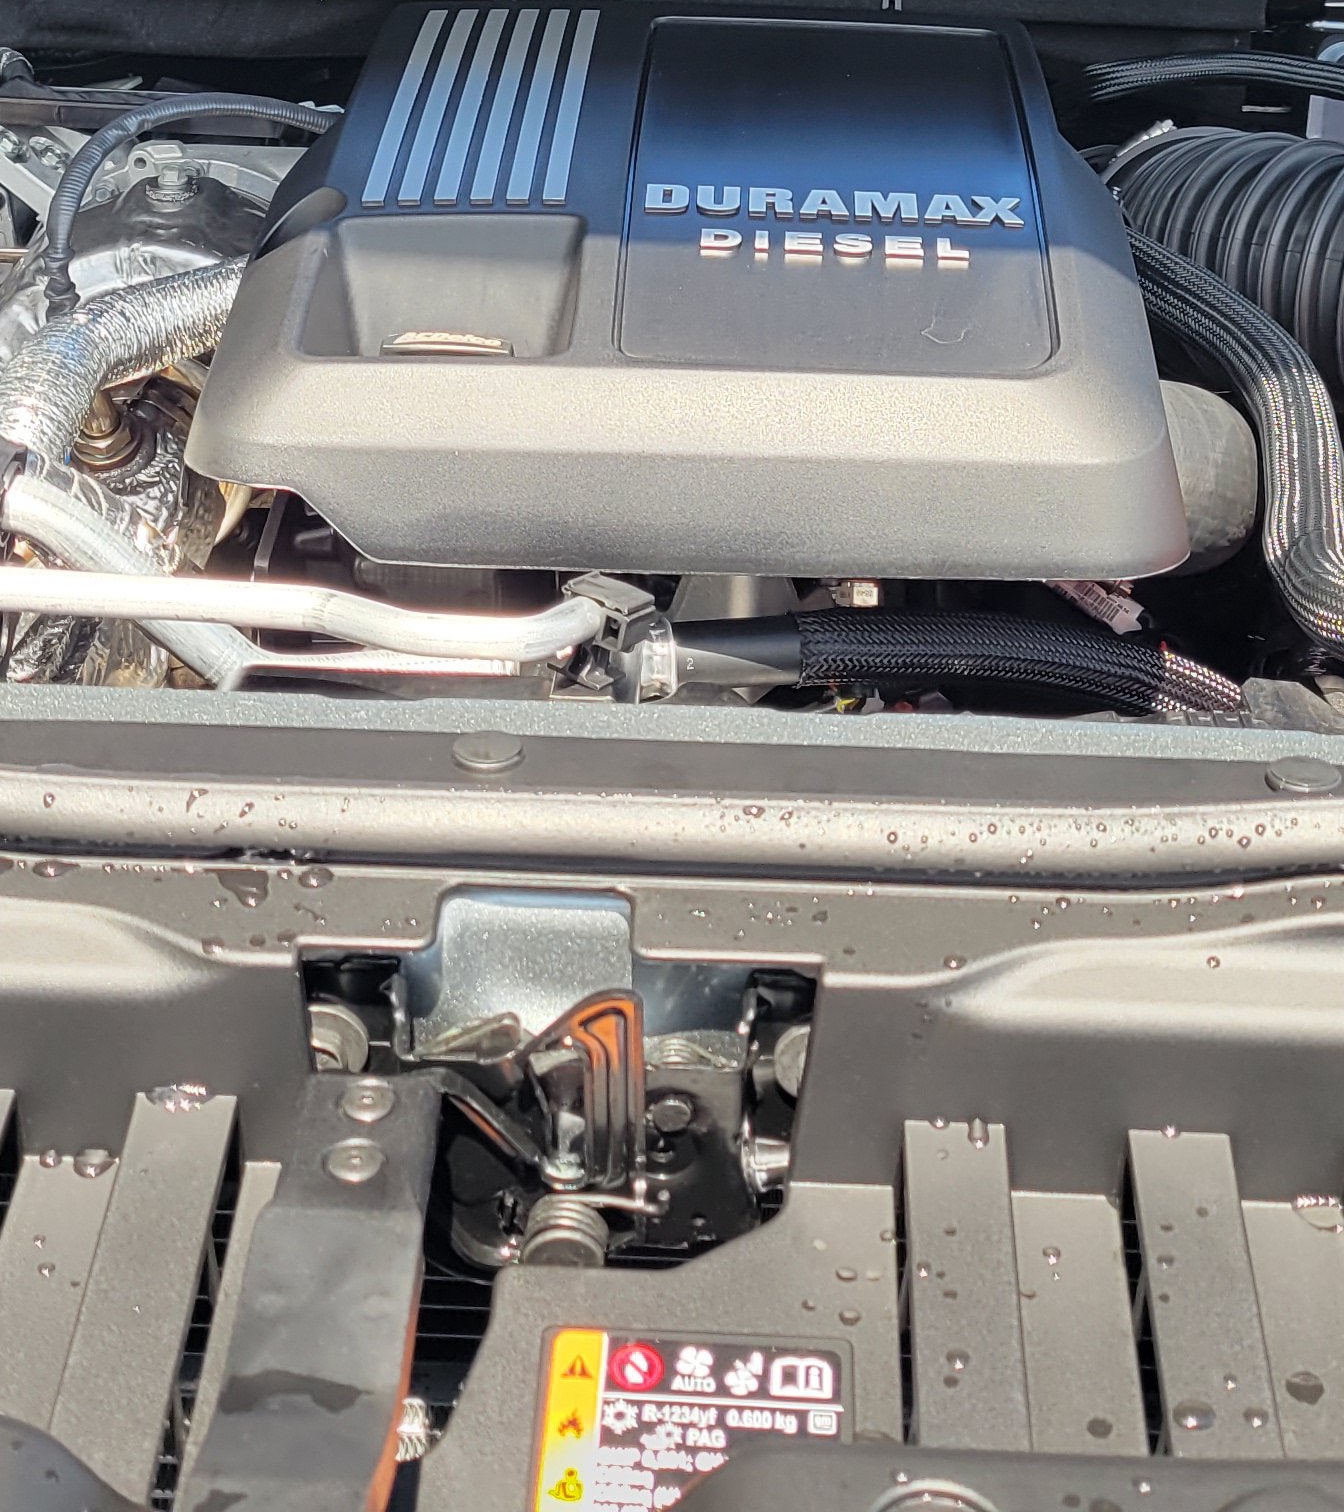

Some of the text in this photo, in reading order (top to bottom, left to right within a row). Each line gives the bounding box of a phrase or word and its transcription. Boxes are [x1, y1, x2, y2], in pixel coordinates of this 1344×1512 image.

[644, 183, 1025, 228] DURAMAX
[699, 228, 971, 262] DIESEL
[686, 657, 695, 671] 2
[671, 1375, 716, 1392] AUTO
[641, 1403, 719, 1427] R-1234yf
[774, 1410, 798, 1434] kg
[685, 1427, 727, 1448] PAG
